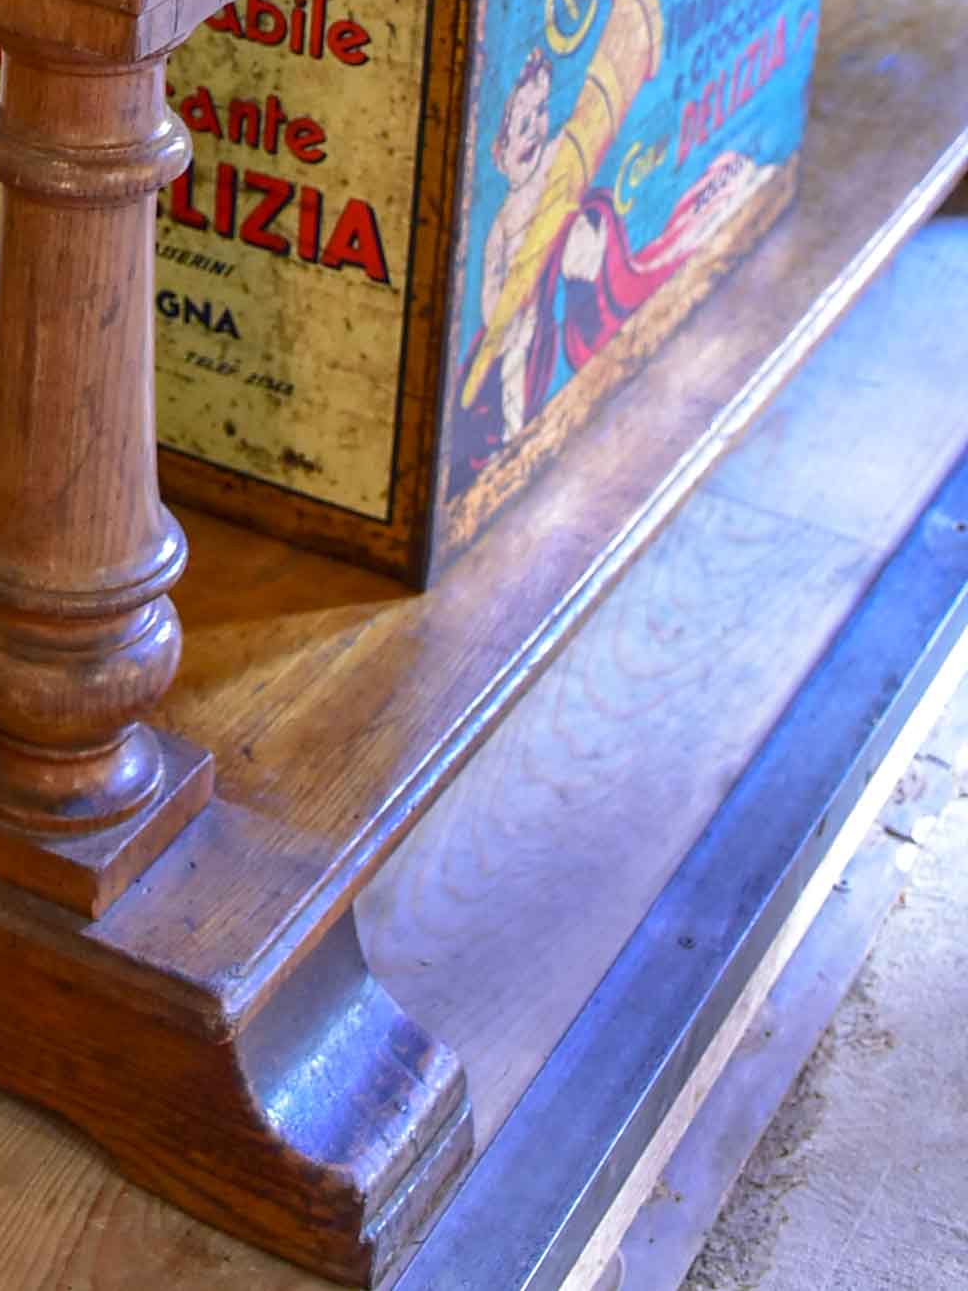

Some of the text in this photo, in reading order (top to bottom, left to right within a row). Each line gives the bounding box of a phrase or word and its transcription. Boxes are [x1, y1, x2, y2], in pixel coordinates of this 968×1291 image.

[168, 83, 327, 164] ante
[158, 161, 391, 284] LIZIA
[156, 289, 241, 340] GNA
